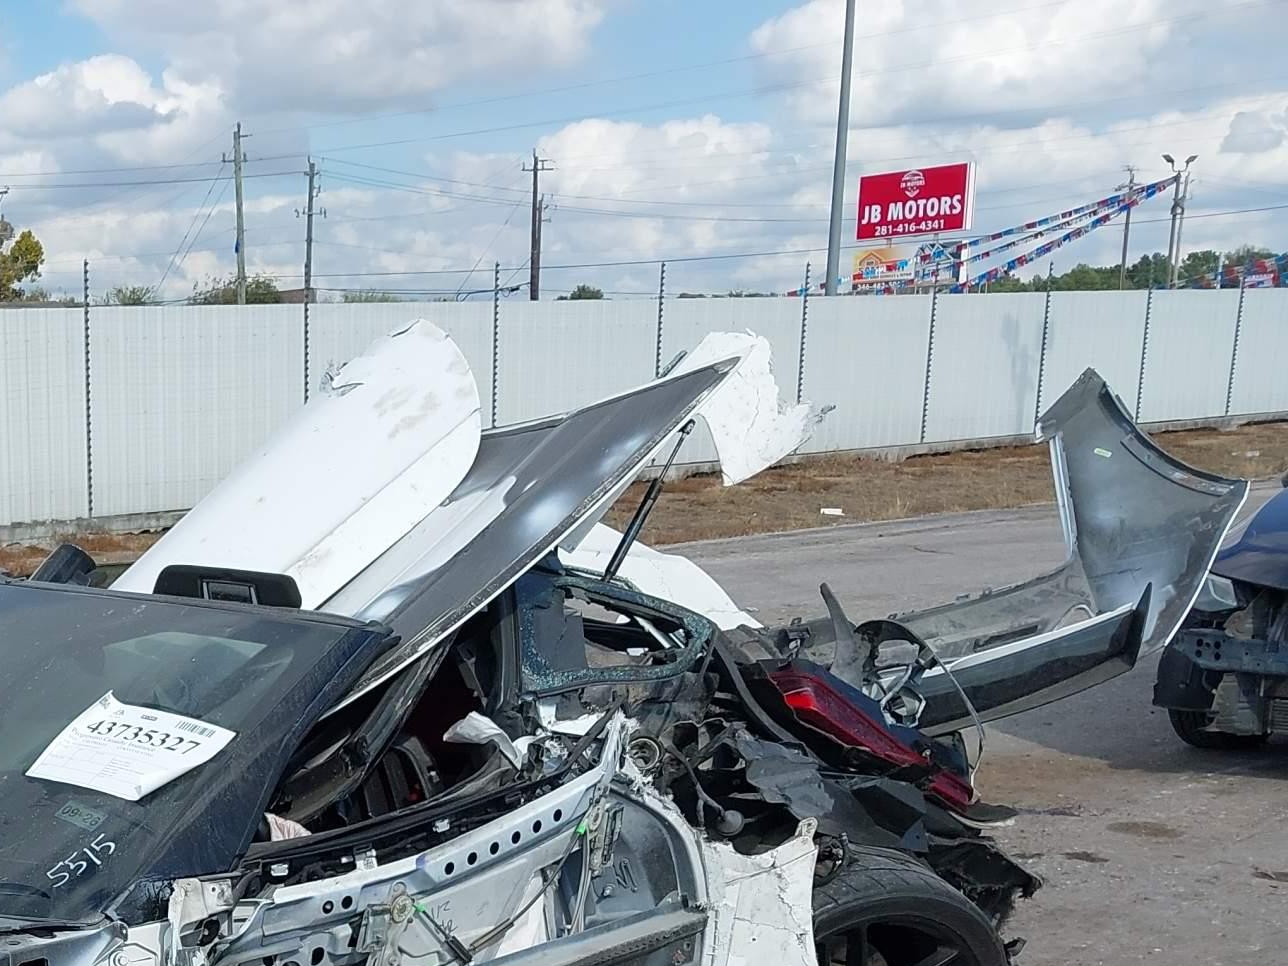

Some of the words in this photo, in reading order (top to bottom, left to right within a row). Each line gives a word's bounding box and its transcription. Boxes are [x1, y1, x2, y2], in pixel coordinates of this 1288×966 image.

[861, 205, 881, 224] JB
[887, 195, 962, 221] MOTORS
[875, 220, 944, 236] 281-416-4341
[86, 719, 202, 755] 43735327
[46, 833, 116, 888] 5515
